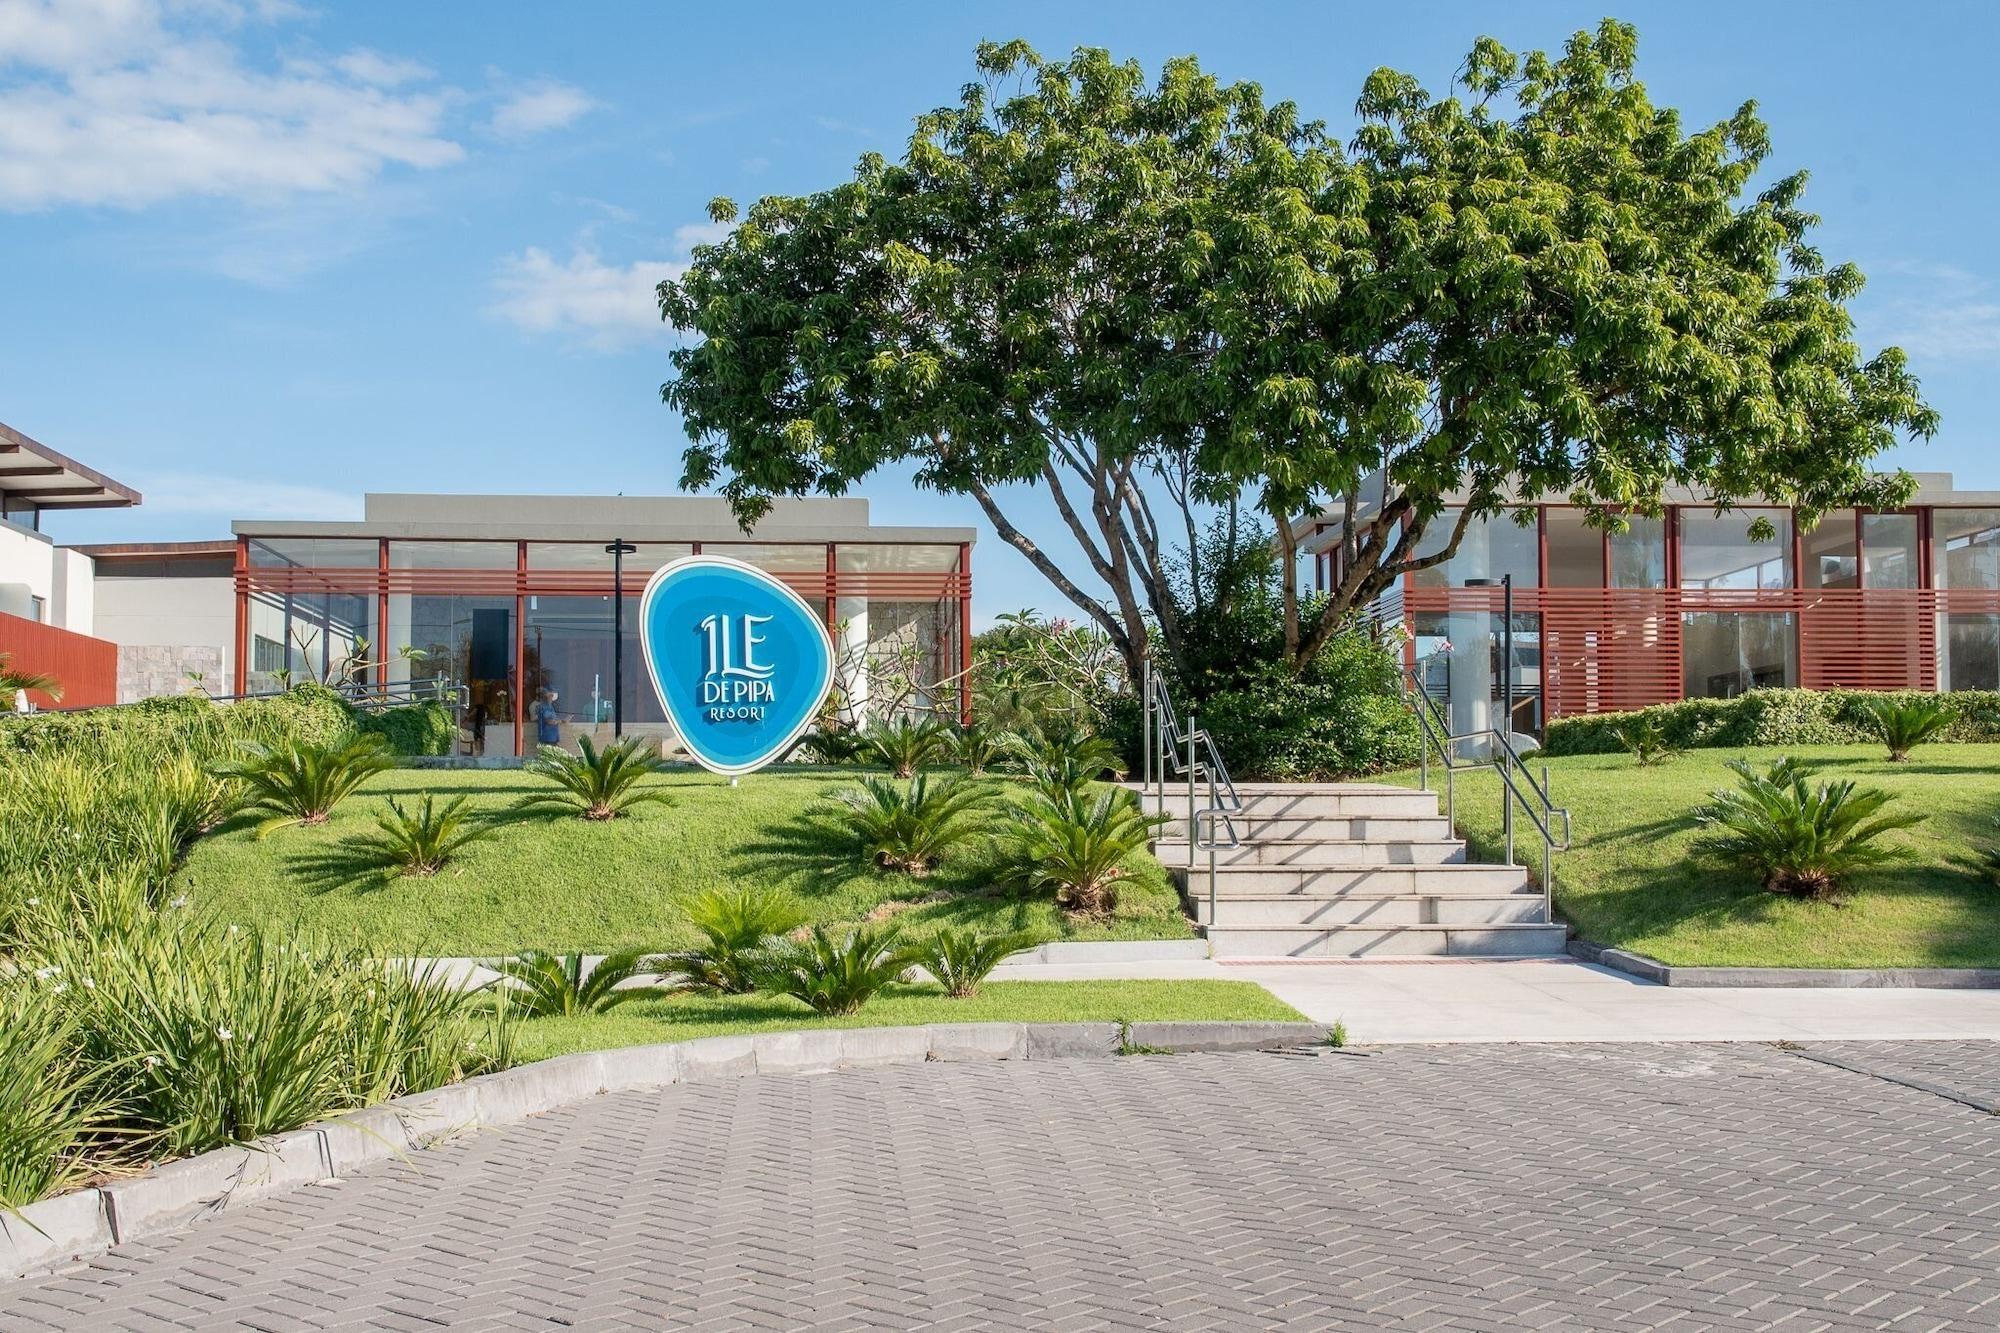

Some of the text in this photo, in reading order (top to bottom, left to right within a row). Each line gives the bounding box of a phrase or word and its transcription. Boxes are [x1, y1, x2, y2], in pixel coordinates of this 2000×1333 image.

[704, 680, 776, 703] DE PIPA
[710, 706, 766, 722] RESORT
